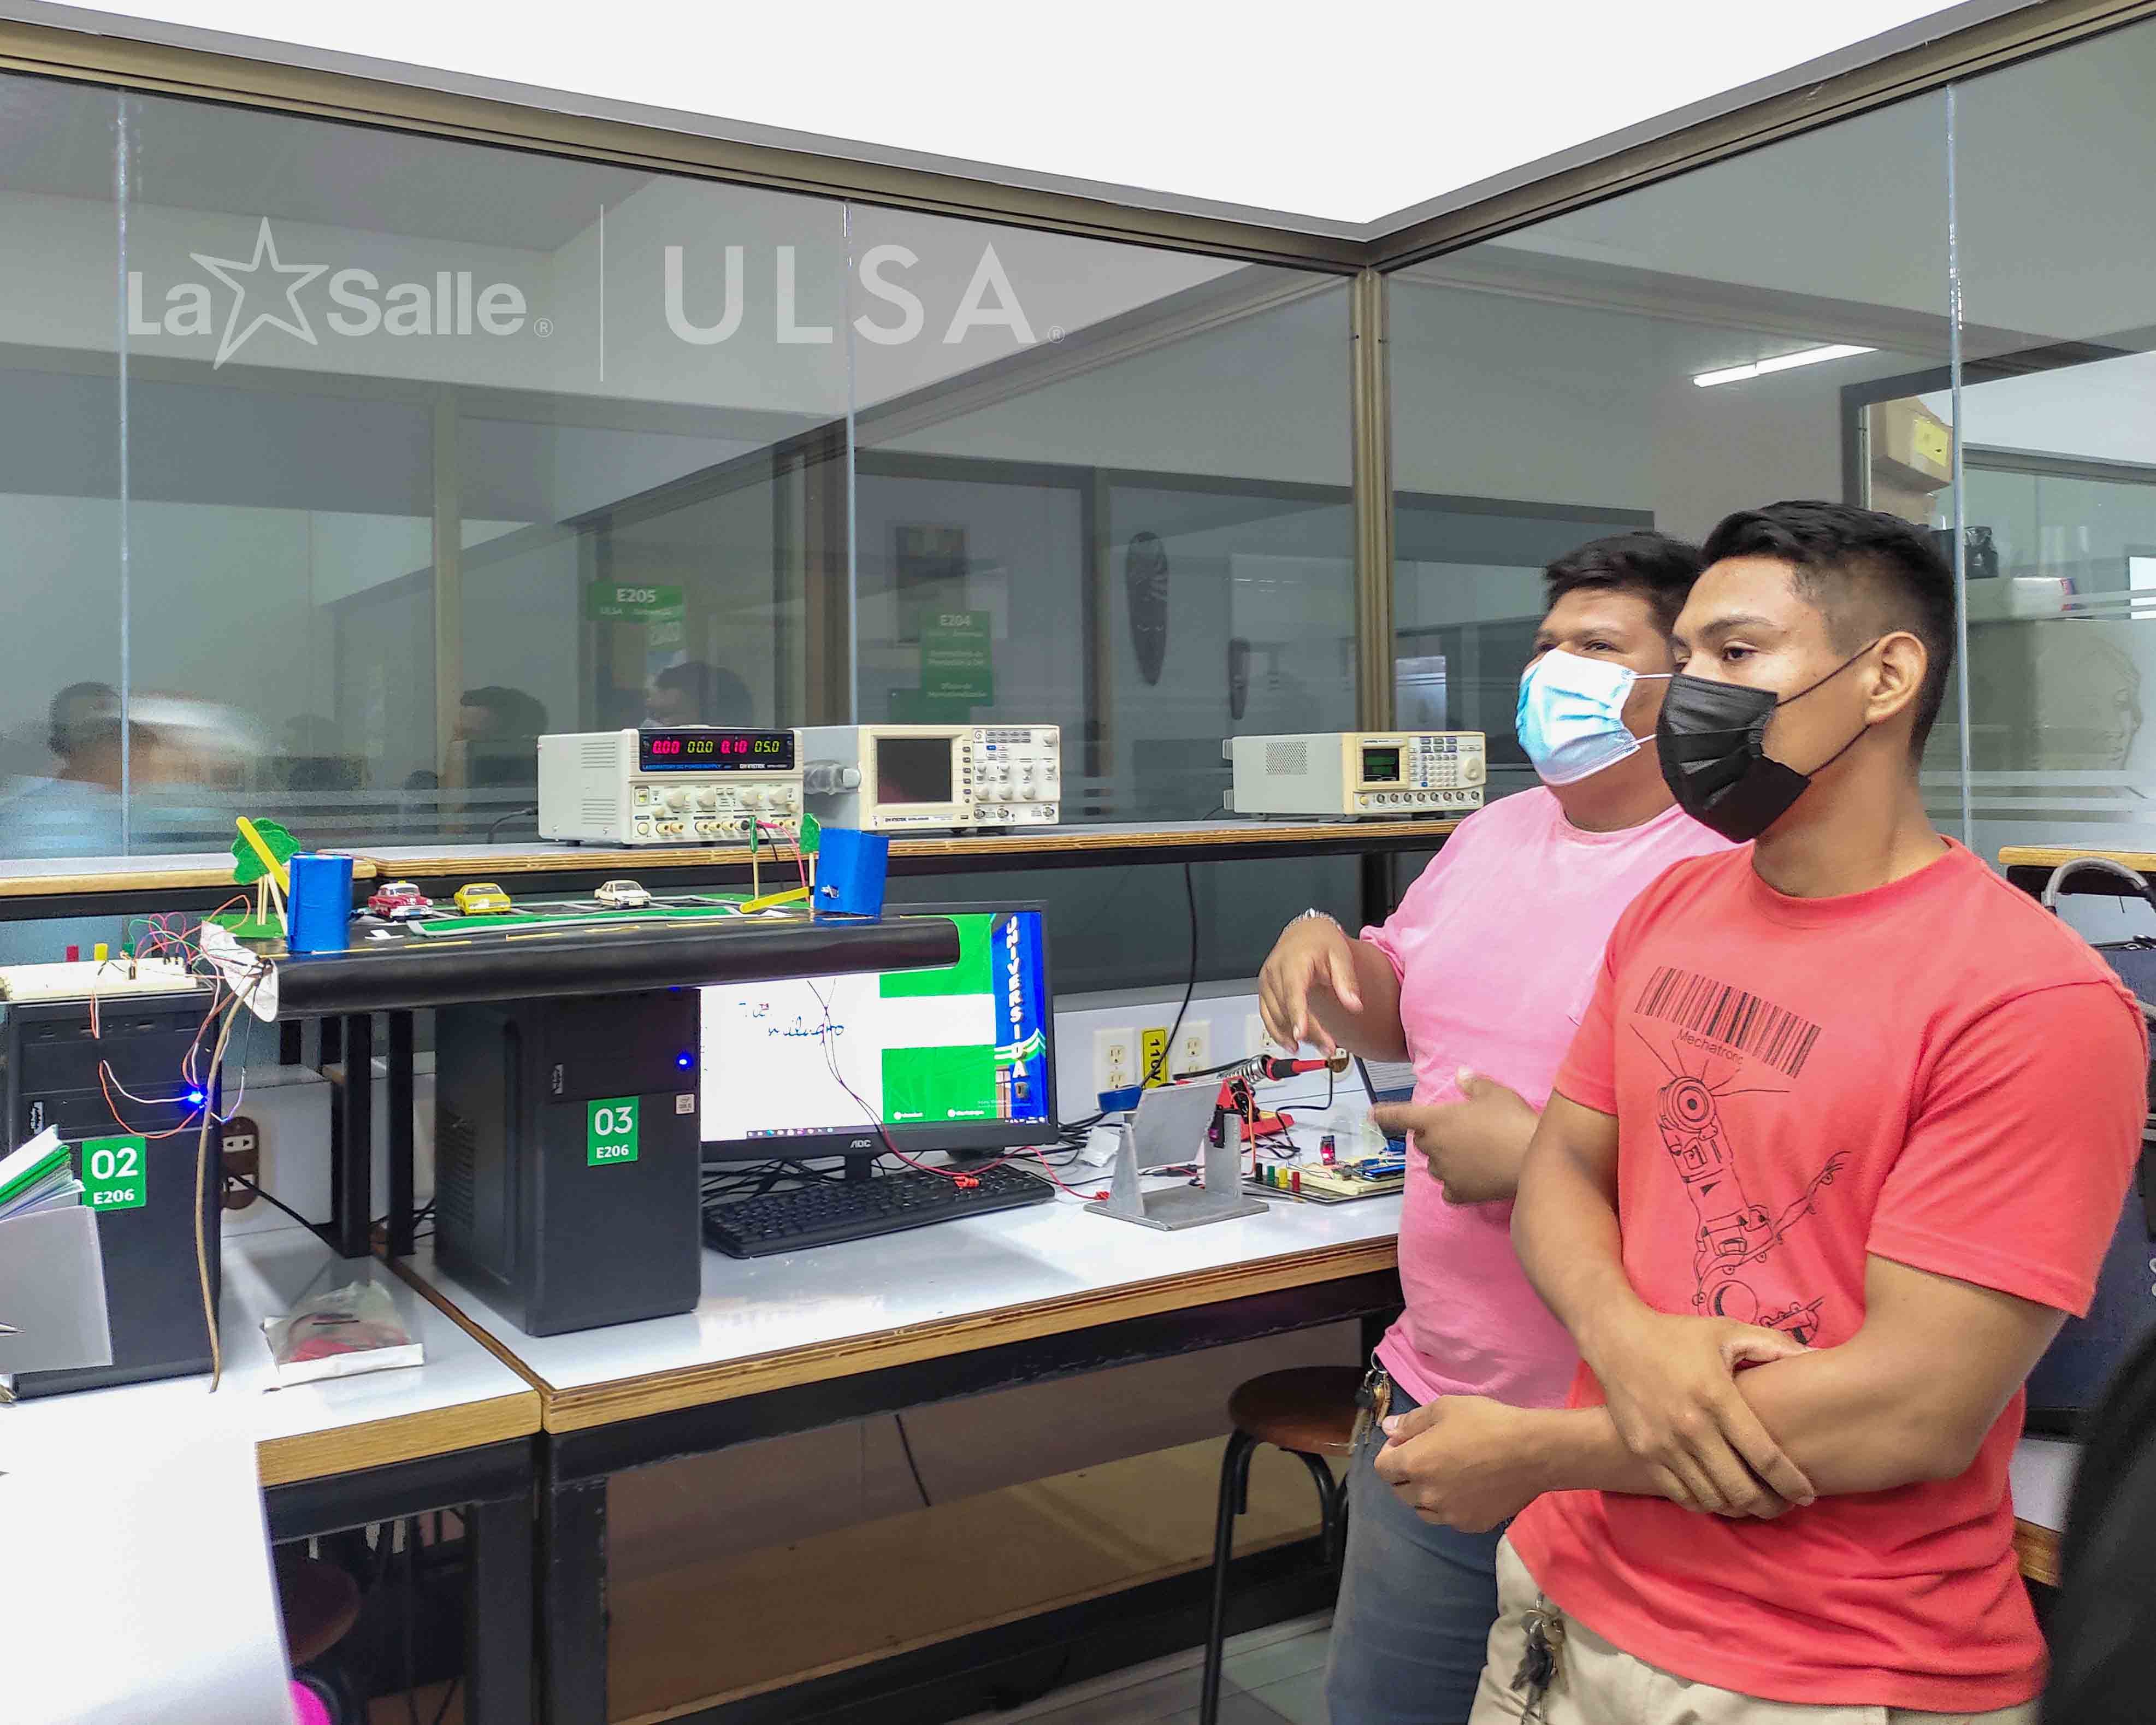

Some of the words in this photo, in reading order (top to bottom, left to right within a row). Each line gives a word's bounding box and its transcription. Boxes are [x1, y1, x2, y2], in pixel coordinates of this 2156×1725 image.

[617, 588, 656, 603] E205
[940, 614, 971, 626] E204
[594, 1106, 633, 1136] 03
[850, 1139, 871, 1148] AOC
[596, 1144, 629, 1159] E206
[91, 1148, 139, 1179] 02
[93, 1189, 135, 1204] E206
